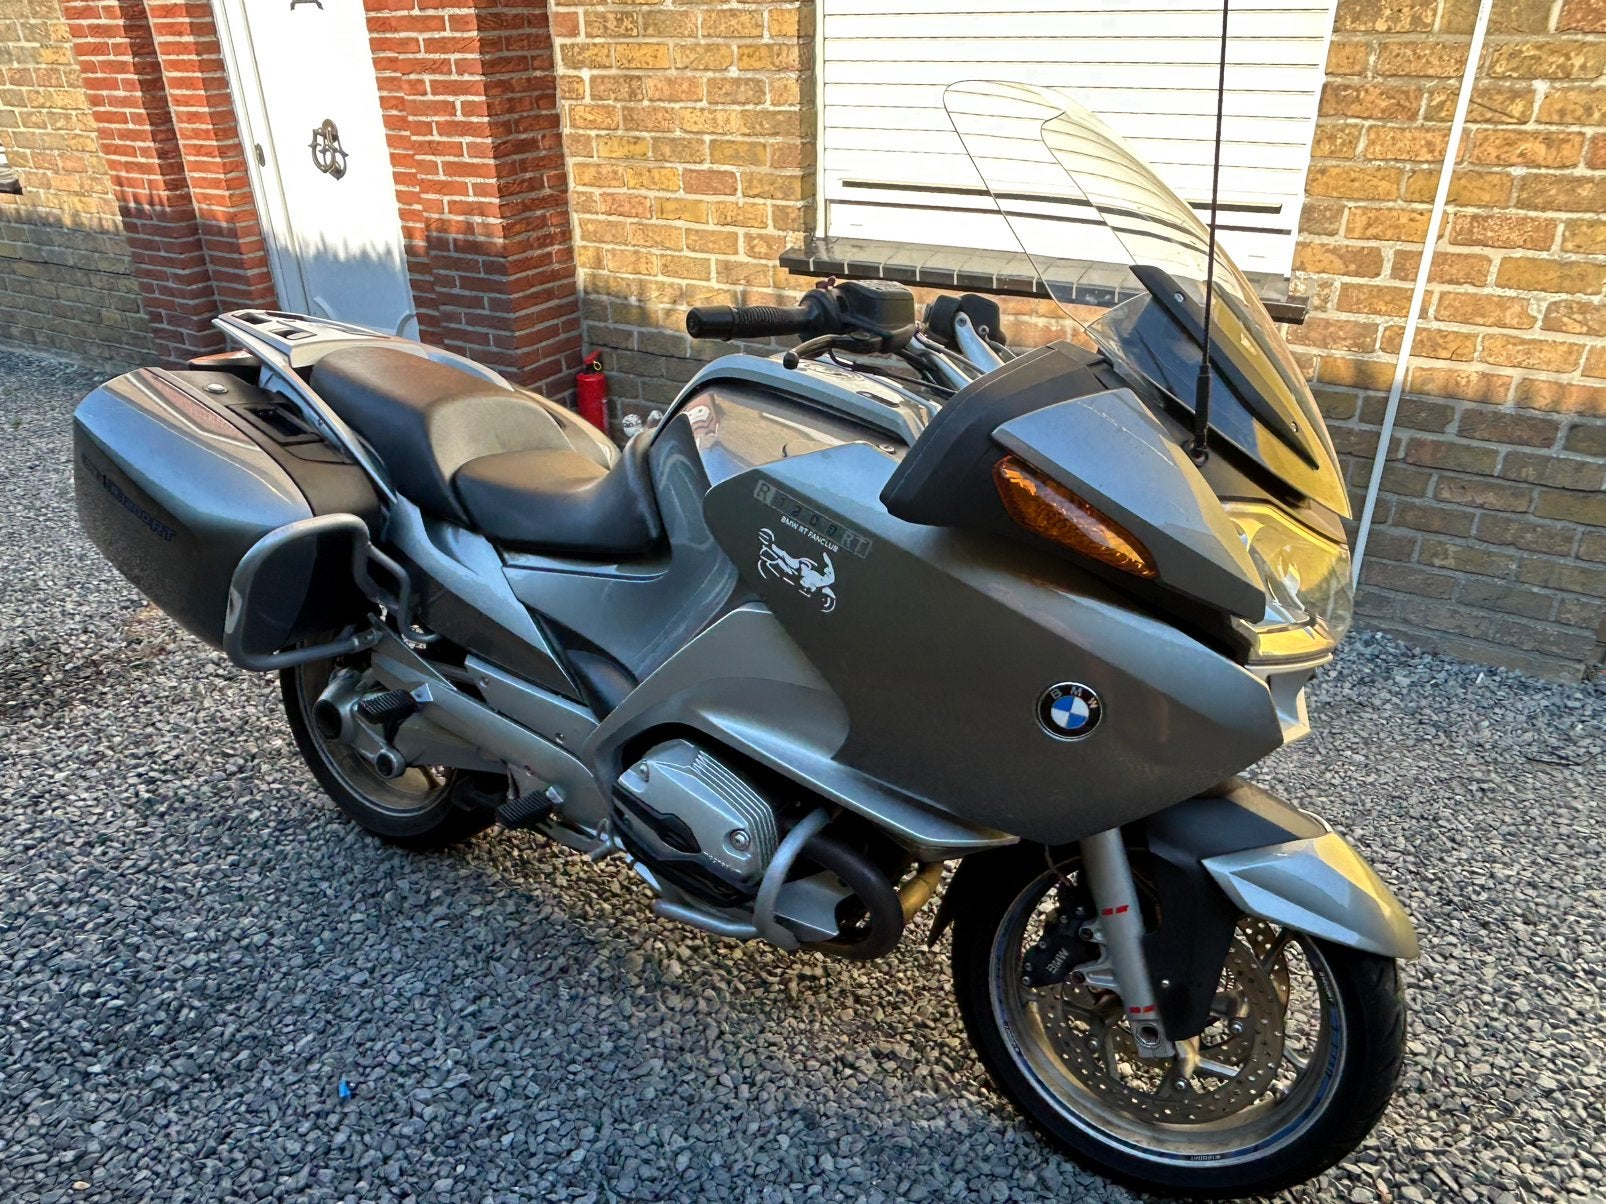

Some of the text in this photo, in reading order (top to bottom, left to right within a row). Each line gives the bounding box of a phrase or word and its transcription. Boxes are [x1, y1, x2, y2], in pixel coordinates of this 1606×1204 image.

[780, 515, 800, 531] BMW
[807, 530, 839, 553] FANCLUB
[1050, 686, 1099, 709] BMW
[1046, 946, 1070, 974] BMW
